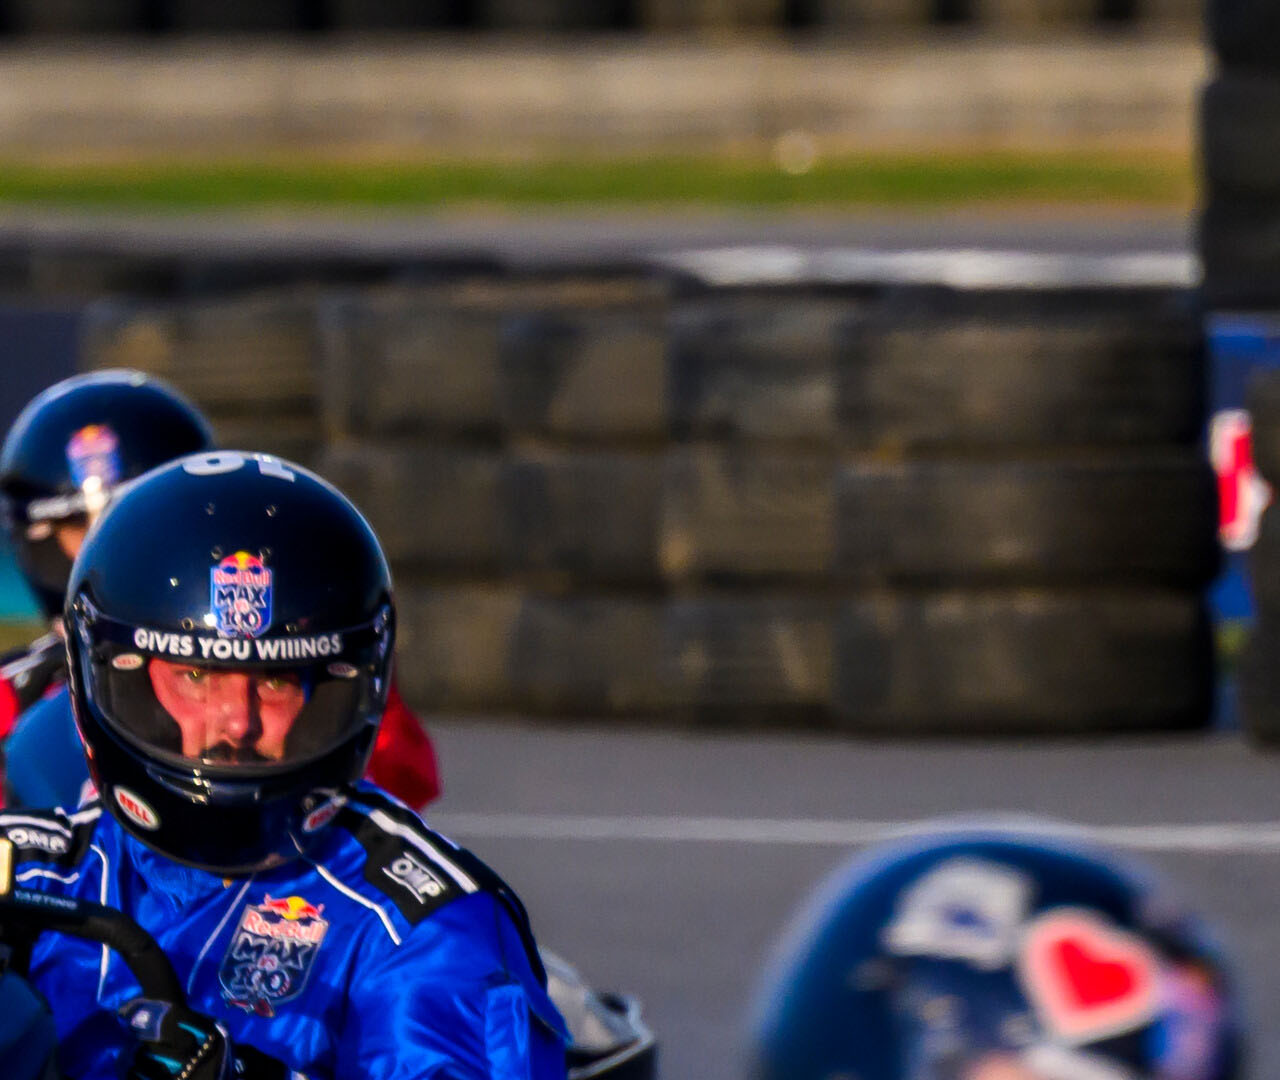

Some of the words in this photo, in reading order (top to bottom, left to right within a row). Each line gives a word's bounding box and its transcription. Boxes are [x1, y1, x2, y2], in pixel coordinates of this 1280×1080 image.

[216, 585, 267, 608] MAX
[134, 627, 193, 657] GIVES
[198, 637, 250, 660] YOU
[255, 634, 342, 660] WIIINGS
[391, 858, 441, 897] OMP
